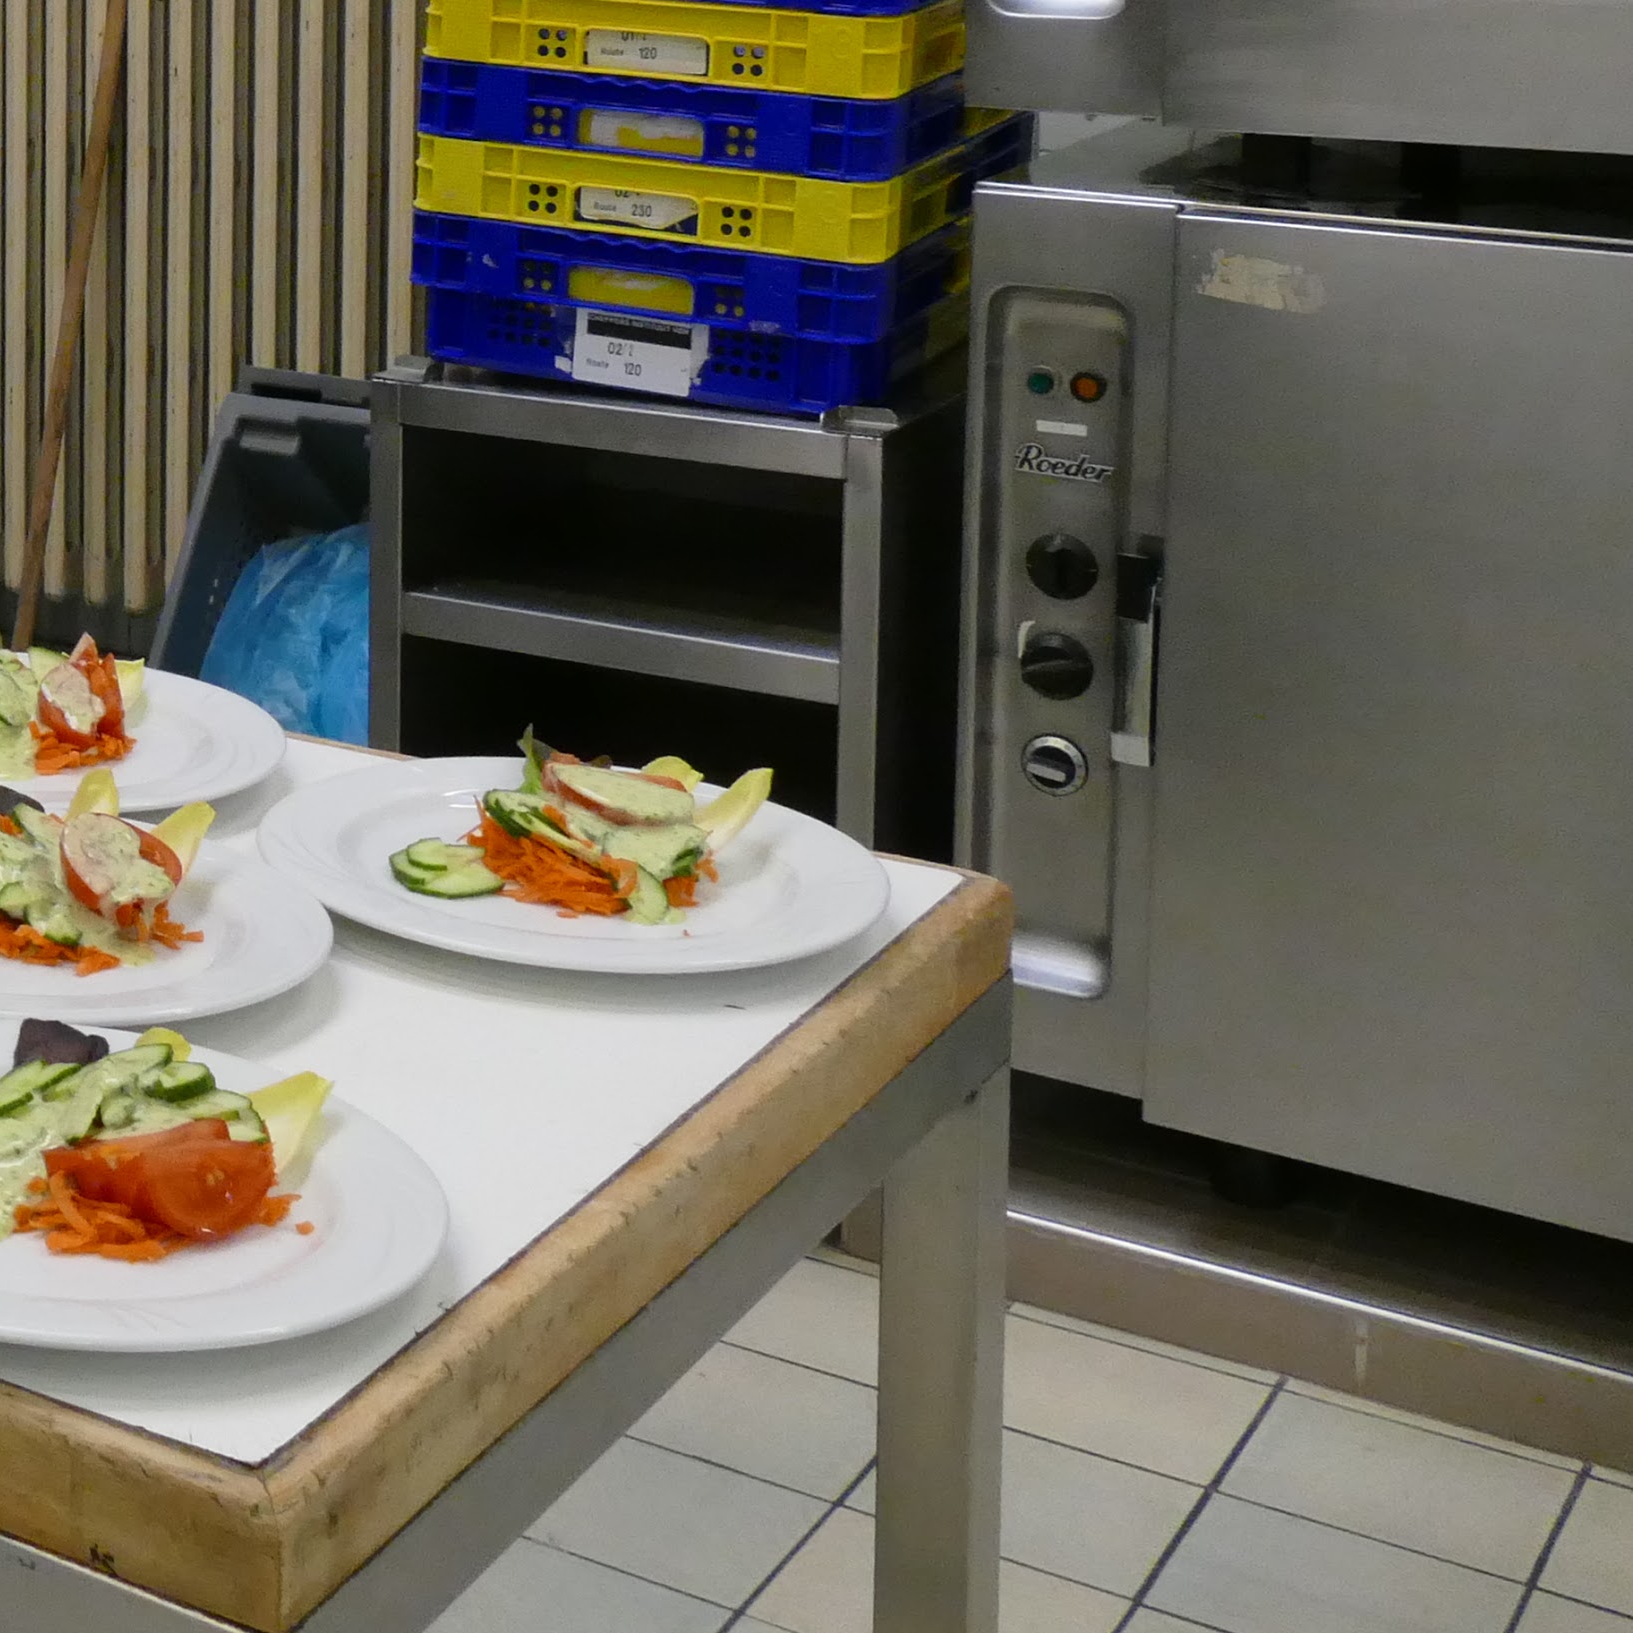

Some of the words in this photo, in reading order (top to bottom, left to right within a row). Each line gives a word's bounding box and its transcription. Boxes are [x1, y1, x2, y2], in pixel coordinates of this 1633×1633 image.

[638, 46, 658, 60] 120
[631, 203, 653, 218] 230
[624, 361, 643, 377] 120
[1014, 443, 1112, 481] Roeder
